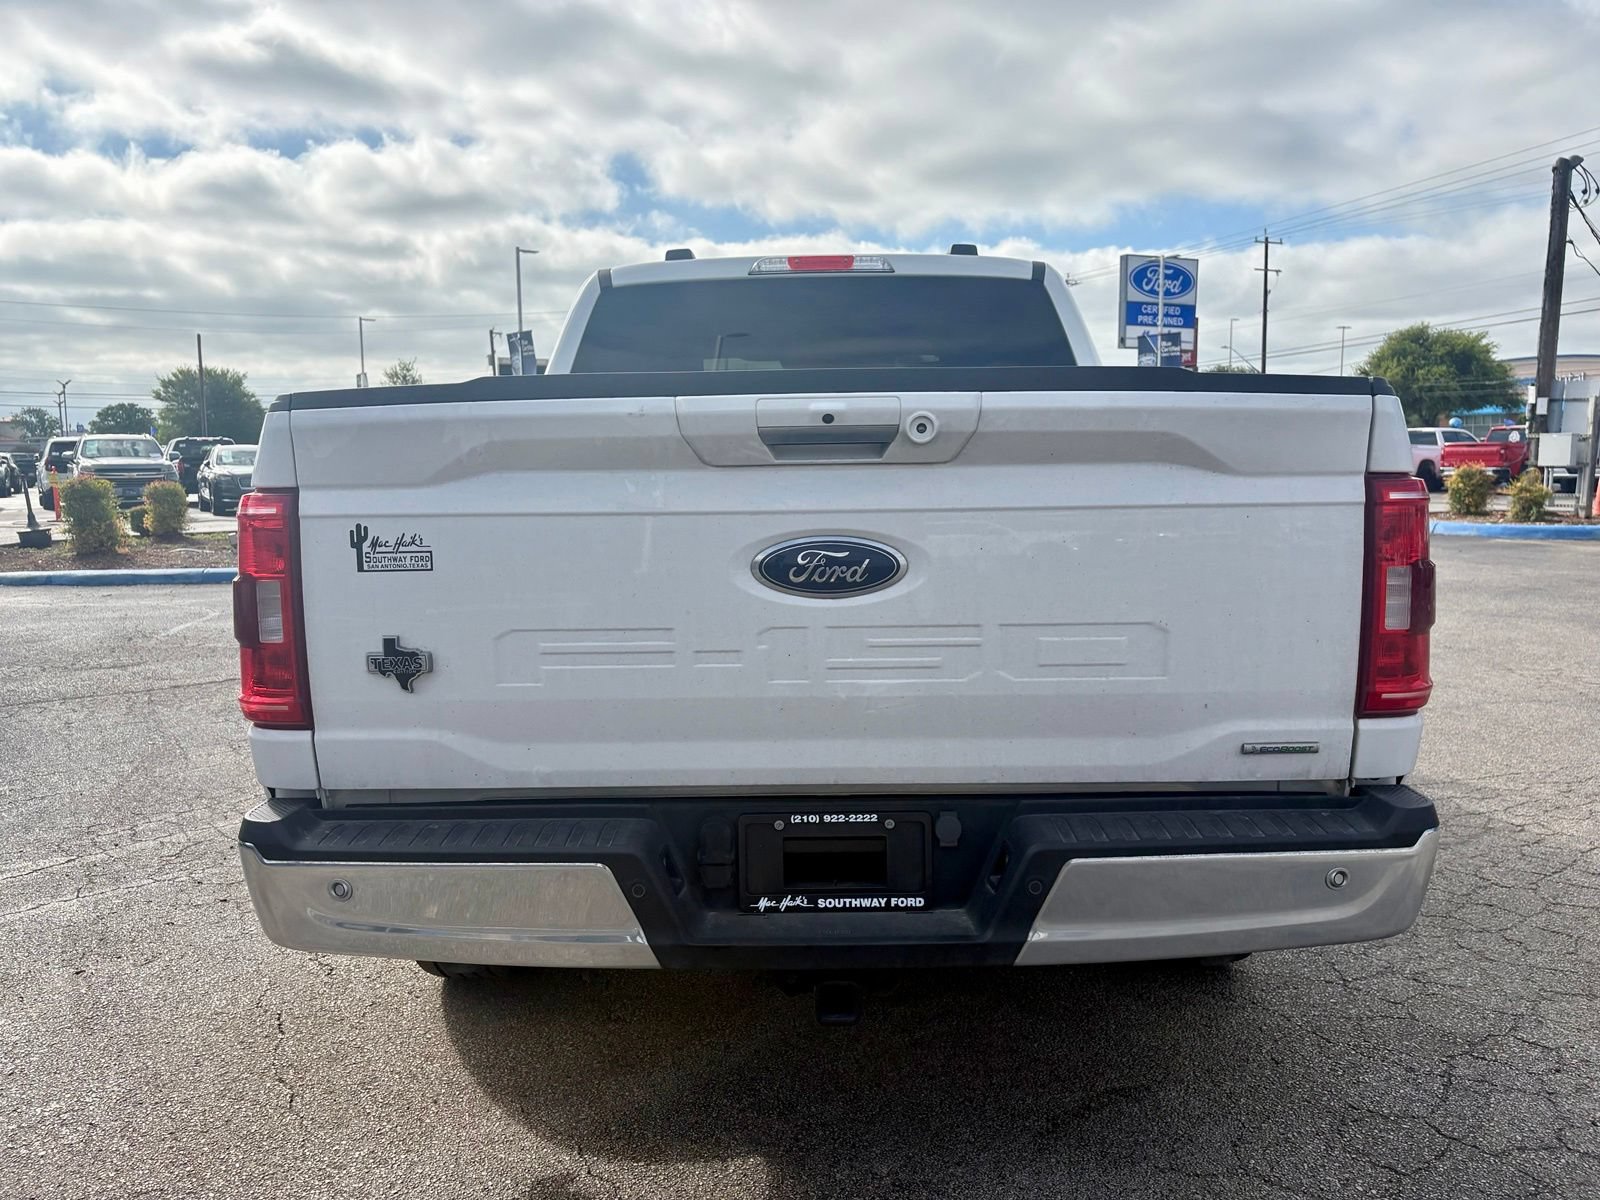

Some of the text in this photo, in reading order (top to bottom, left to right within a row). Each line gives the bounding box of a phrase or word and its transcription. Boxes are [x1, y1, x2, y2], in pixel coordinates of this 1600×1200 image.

[1141, 304, 1181, 315] CERFIED
[367, 535, 392, 555] Mac
[364, 552, 430, 563] SOUTHWAY FORD
[788, 549, 871, 583] Ford
[370, 657, 423, 670] TEXAS
[790, 814, 878, 824] (210) 922-2222
[817, 897, 888, 908] SOUTHWAY
[890, 897, 925, 907] FORD
